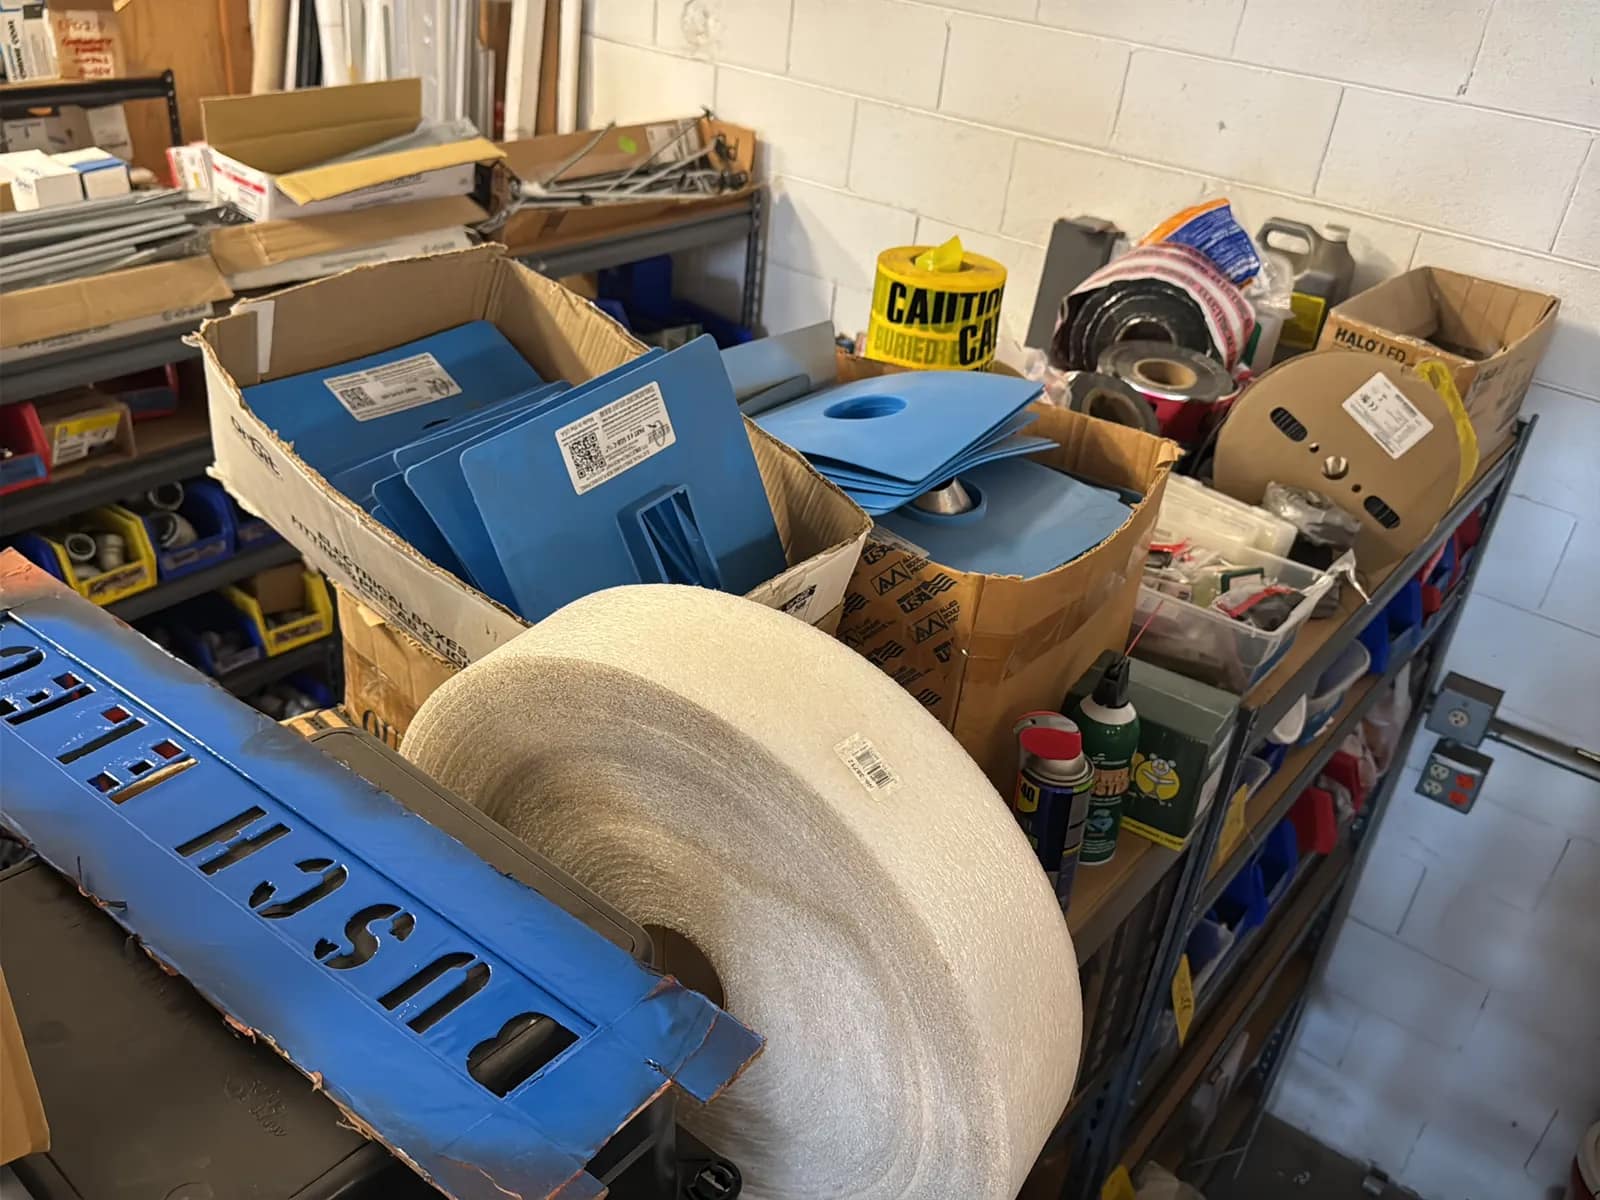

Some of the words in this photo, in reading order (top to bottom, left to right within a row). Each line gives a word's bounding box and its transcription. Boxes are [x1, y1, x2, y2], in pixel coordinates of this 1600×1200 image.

[1335, 327, 1376, 353] HALO
[318, 530, 405, 615] ELECTRICAL
[175, 806, 580, 1099] BUSCH
